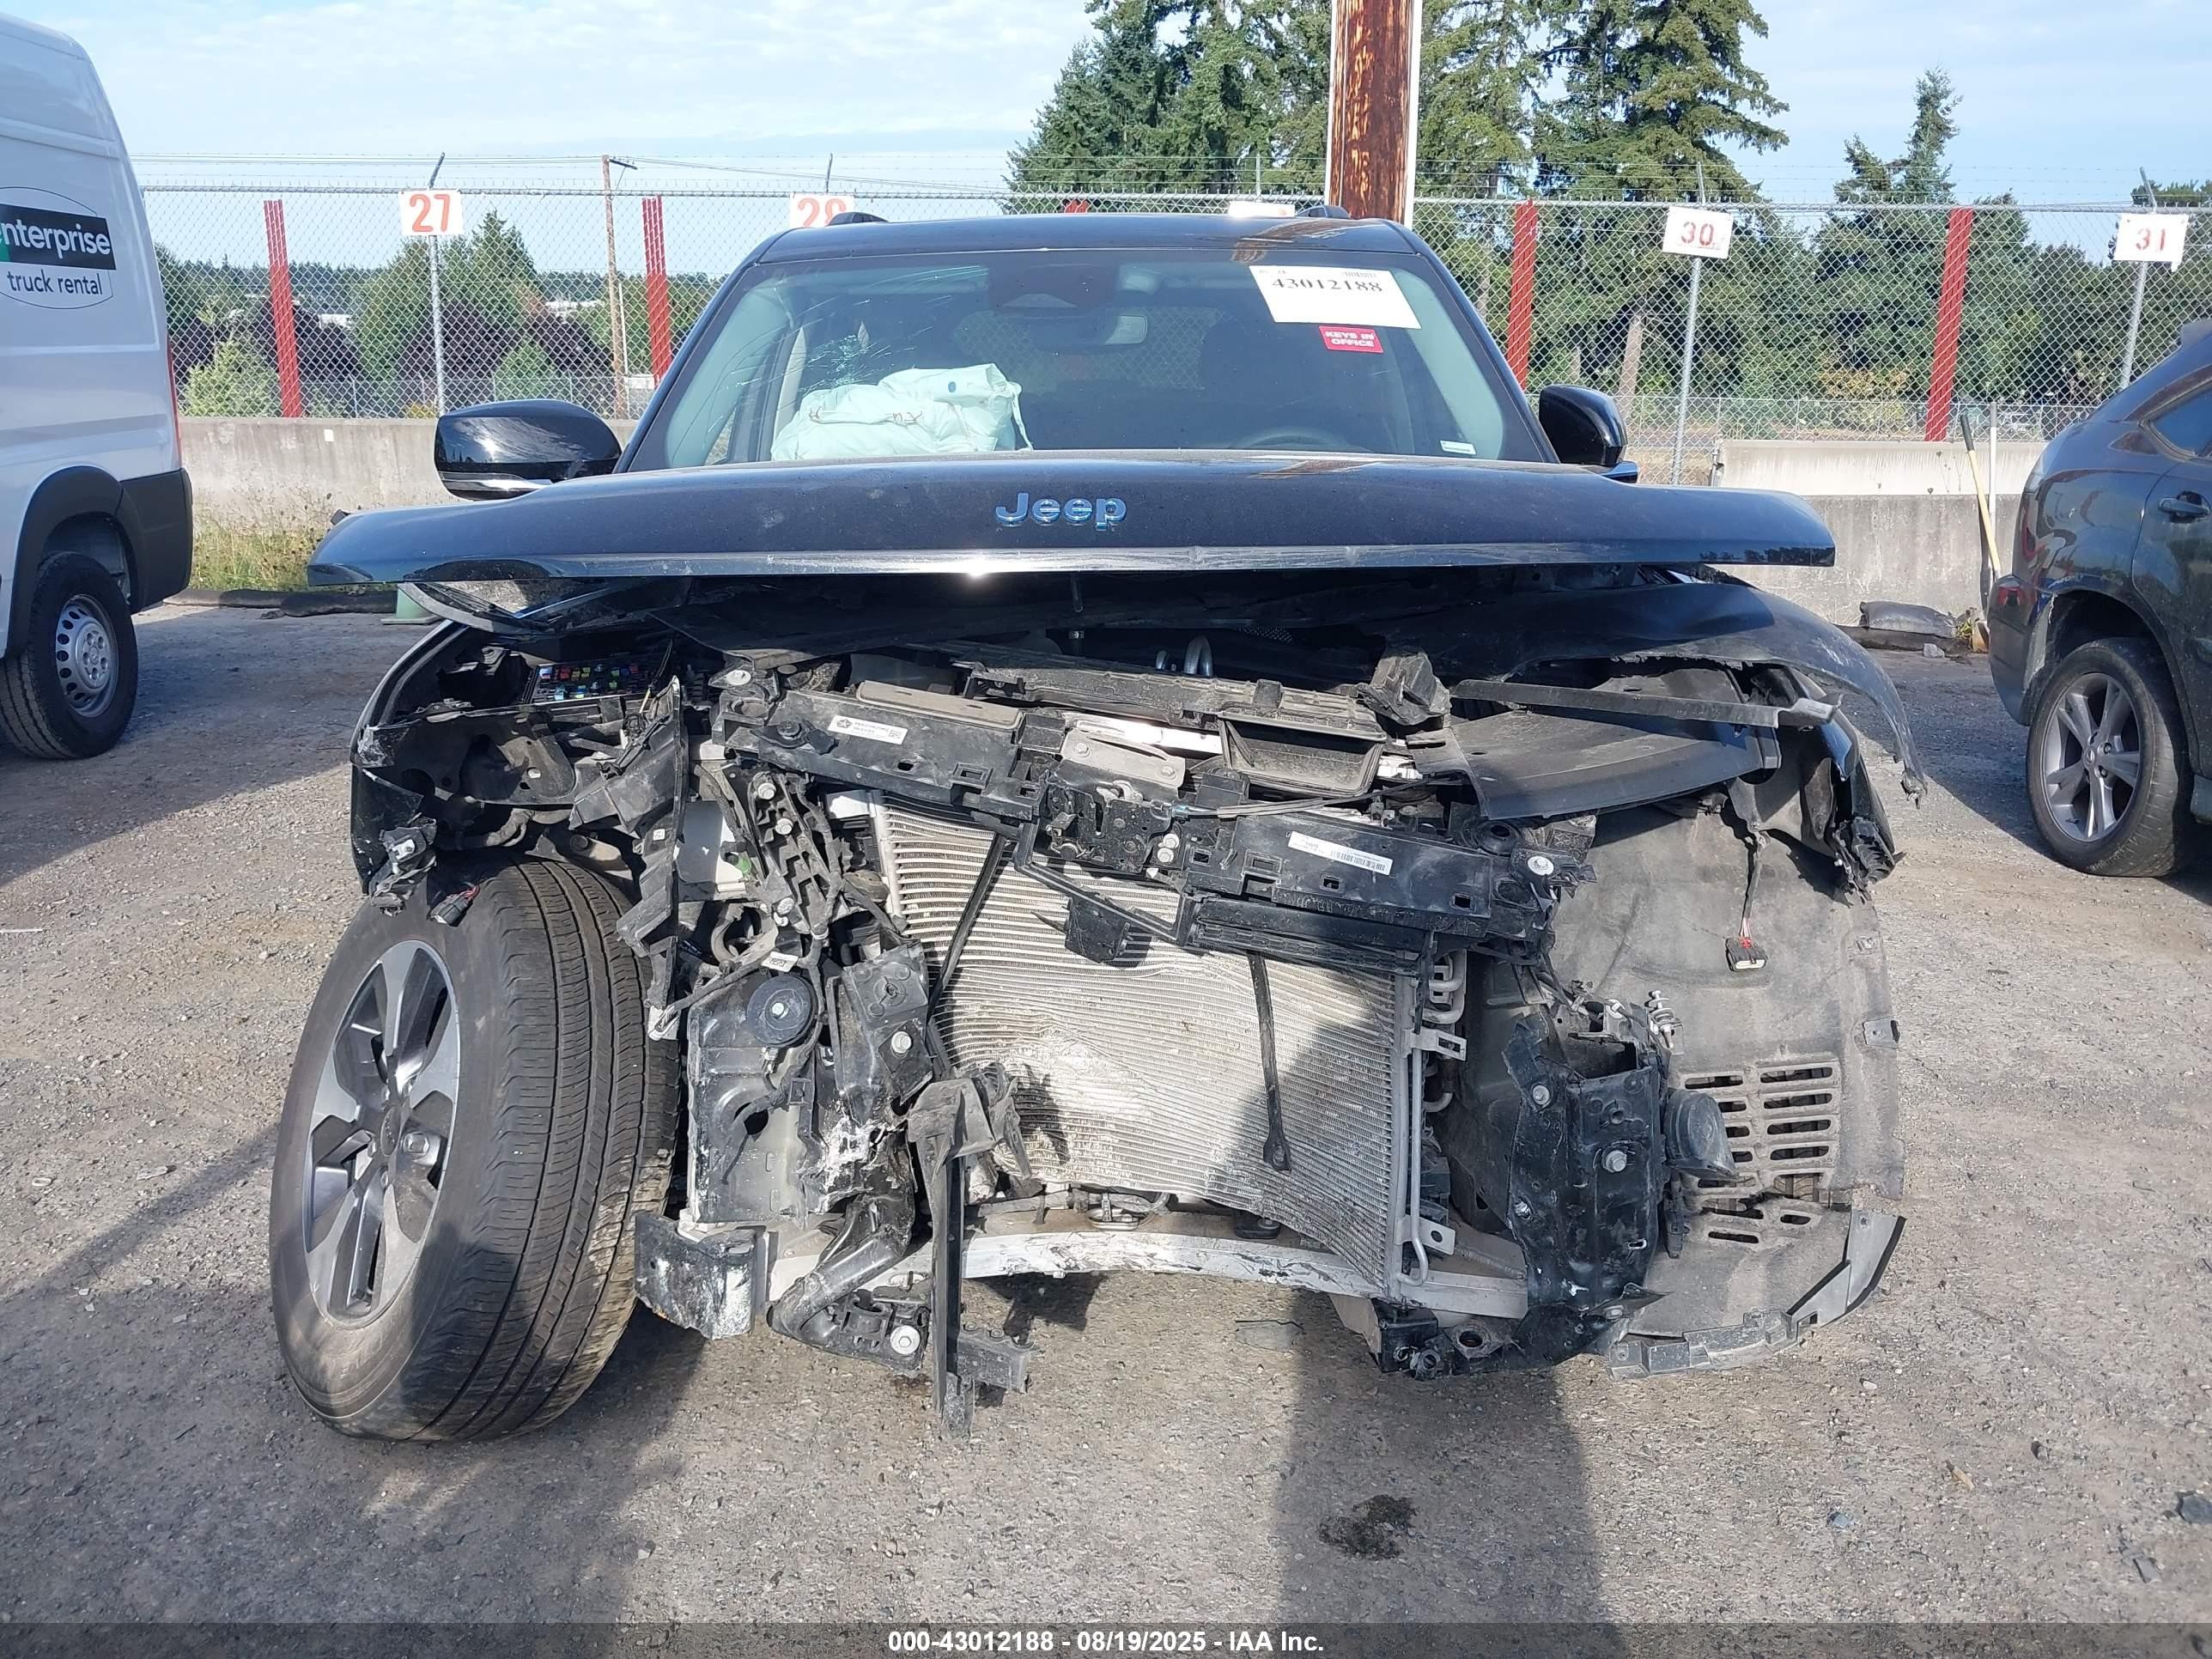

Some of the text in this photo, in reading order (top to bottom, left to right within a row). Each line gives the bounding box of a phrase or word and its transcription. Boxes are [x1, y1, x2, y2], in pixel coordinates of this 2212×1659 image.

[410, 193, 451, 232] 27
[0, 218, 111, 259] nterprise
[1680, 221, 1715, 246] 30
[2136, 228, 2166, 251] 31
[7, 269, 103, 295] truck rental
[1272, 277, 1383, 292] 43012188
[1325, 331, 1375, 341] KEYS IN
[1331, 338, 1375, 348] OFFICE
[995, 492, 1127, 532] Jeep
